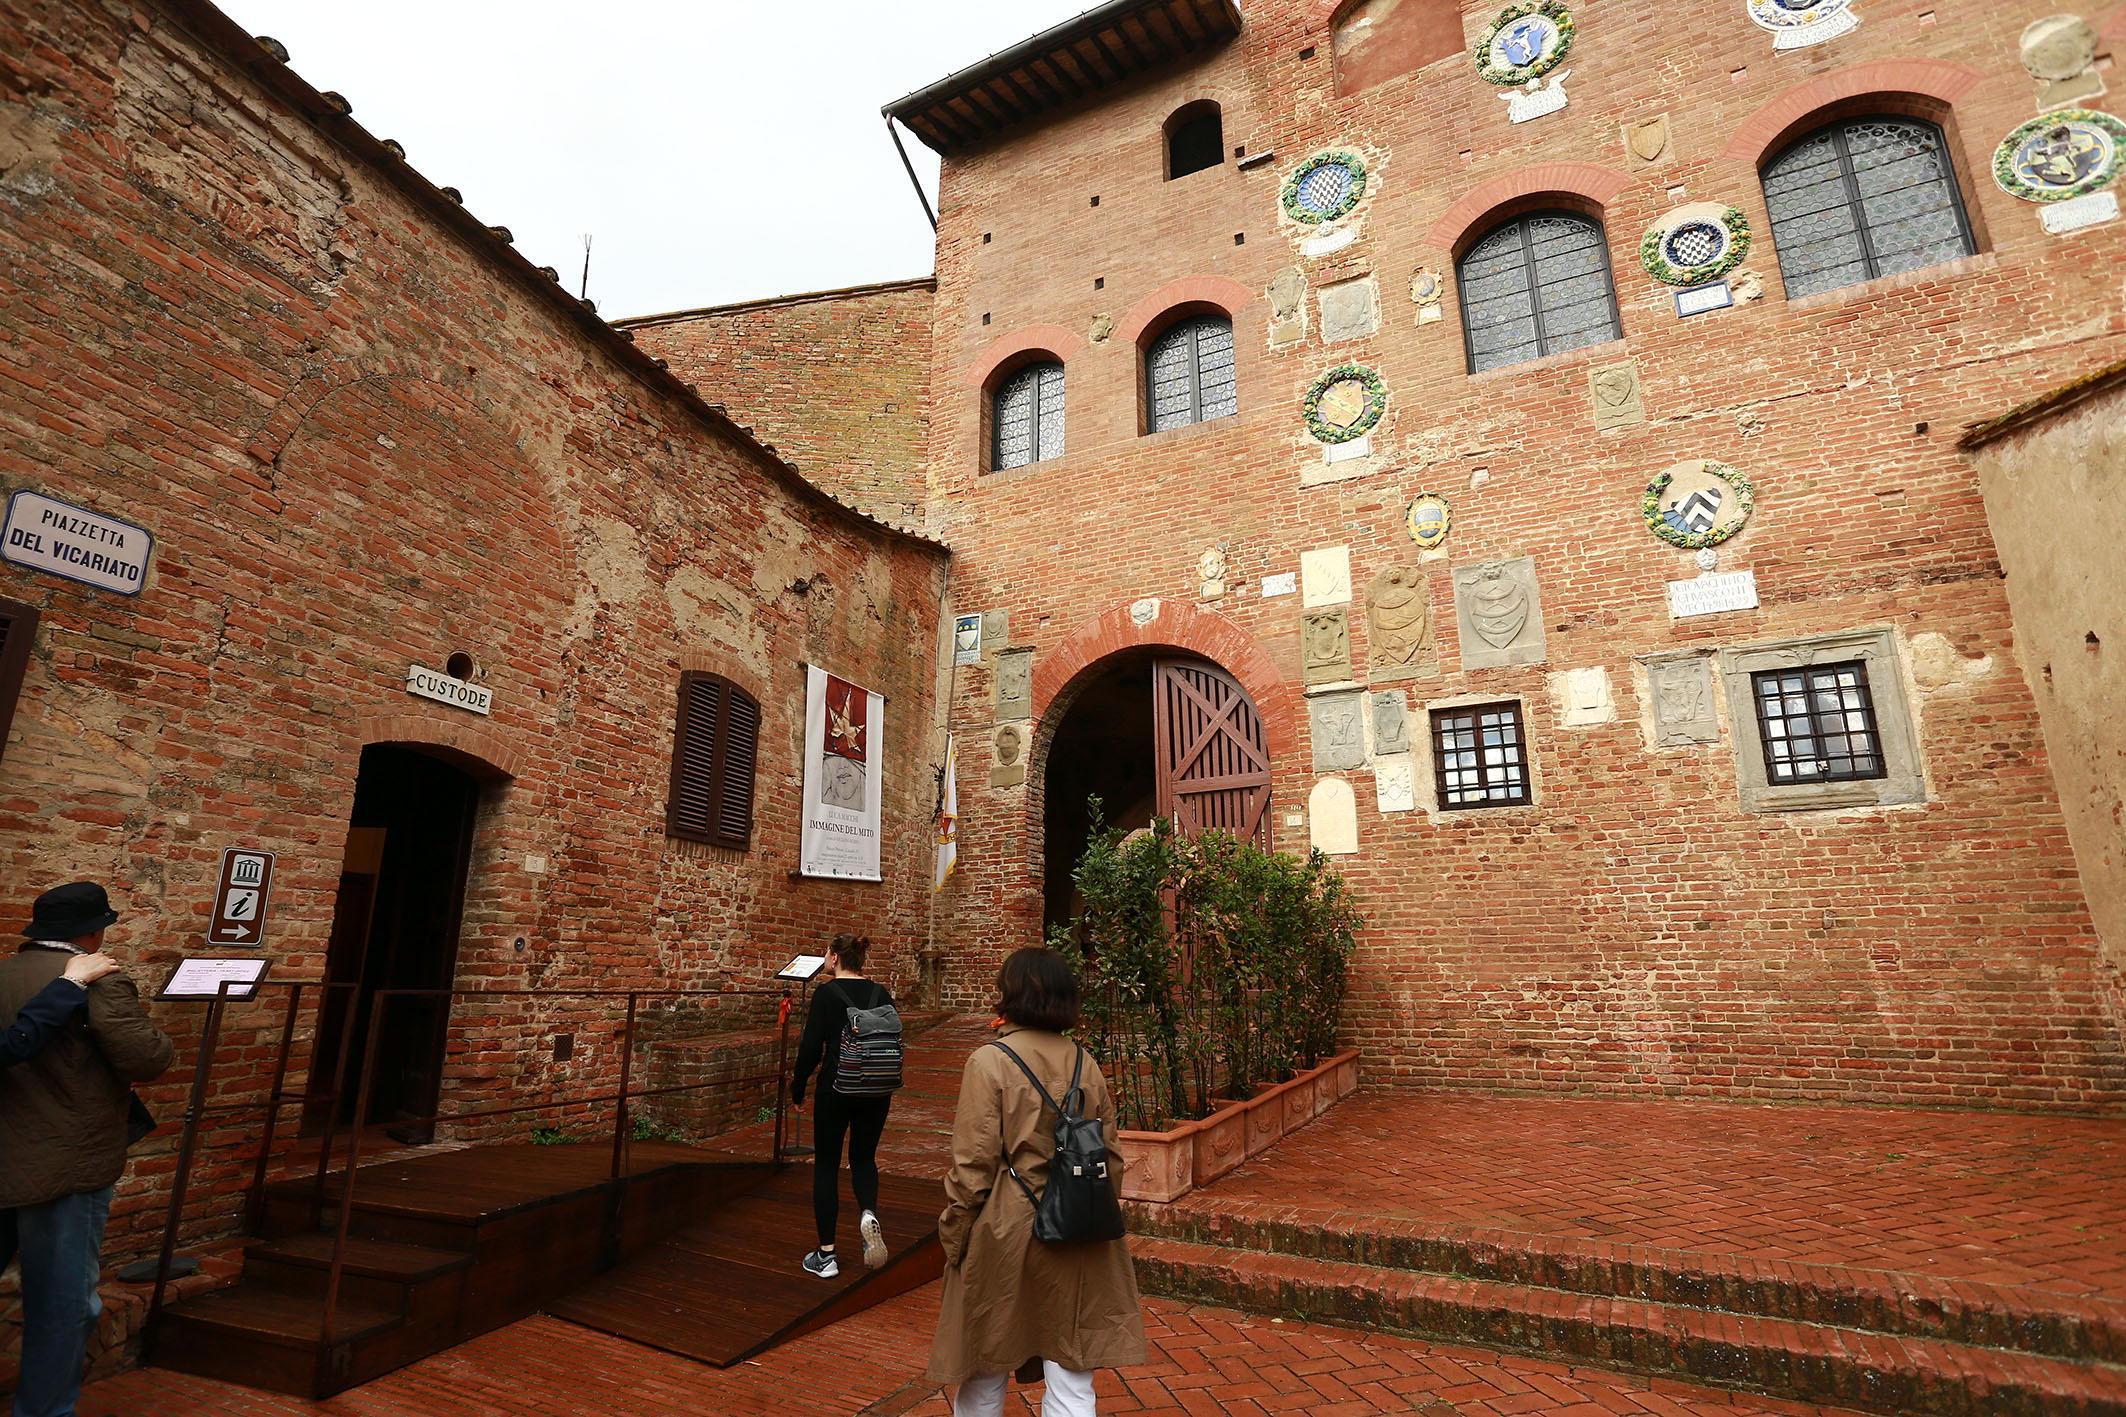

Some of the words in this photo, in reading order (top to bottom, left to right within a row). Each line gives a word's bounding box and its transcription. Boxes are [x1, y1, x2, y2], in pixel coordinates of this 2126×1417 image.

[41, 509, 124, 549] PIAZZETTA
[10, 528, 44, 554] DEL
[53, 540, 139, 581] VICARIATO
[416, 674, 488, 708] CUSTODE
[810, 819, 844, 833] IMMAGINE
[845, 825, 858, 836] DEL
[858, 828, 874, 838] MITO
